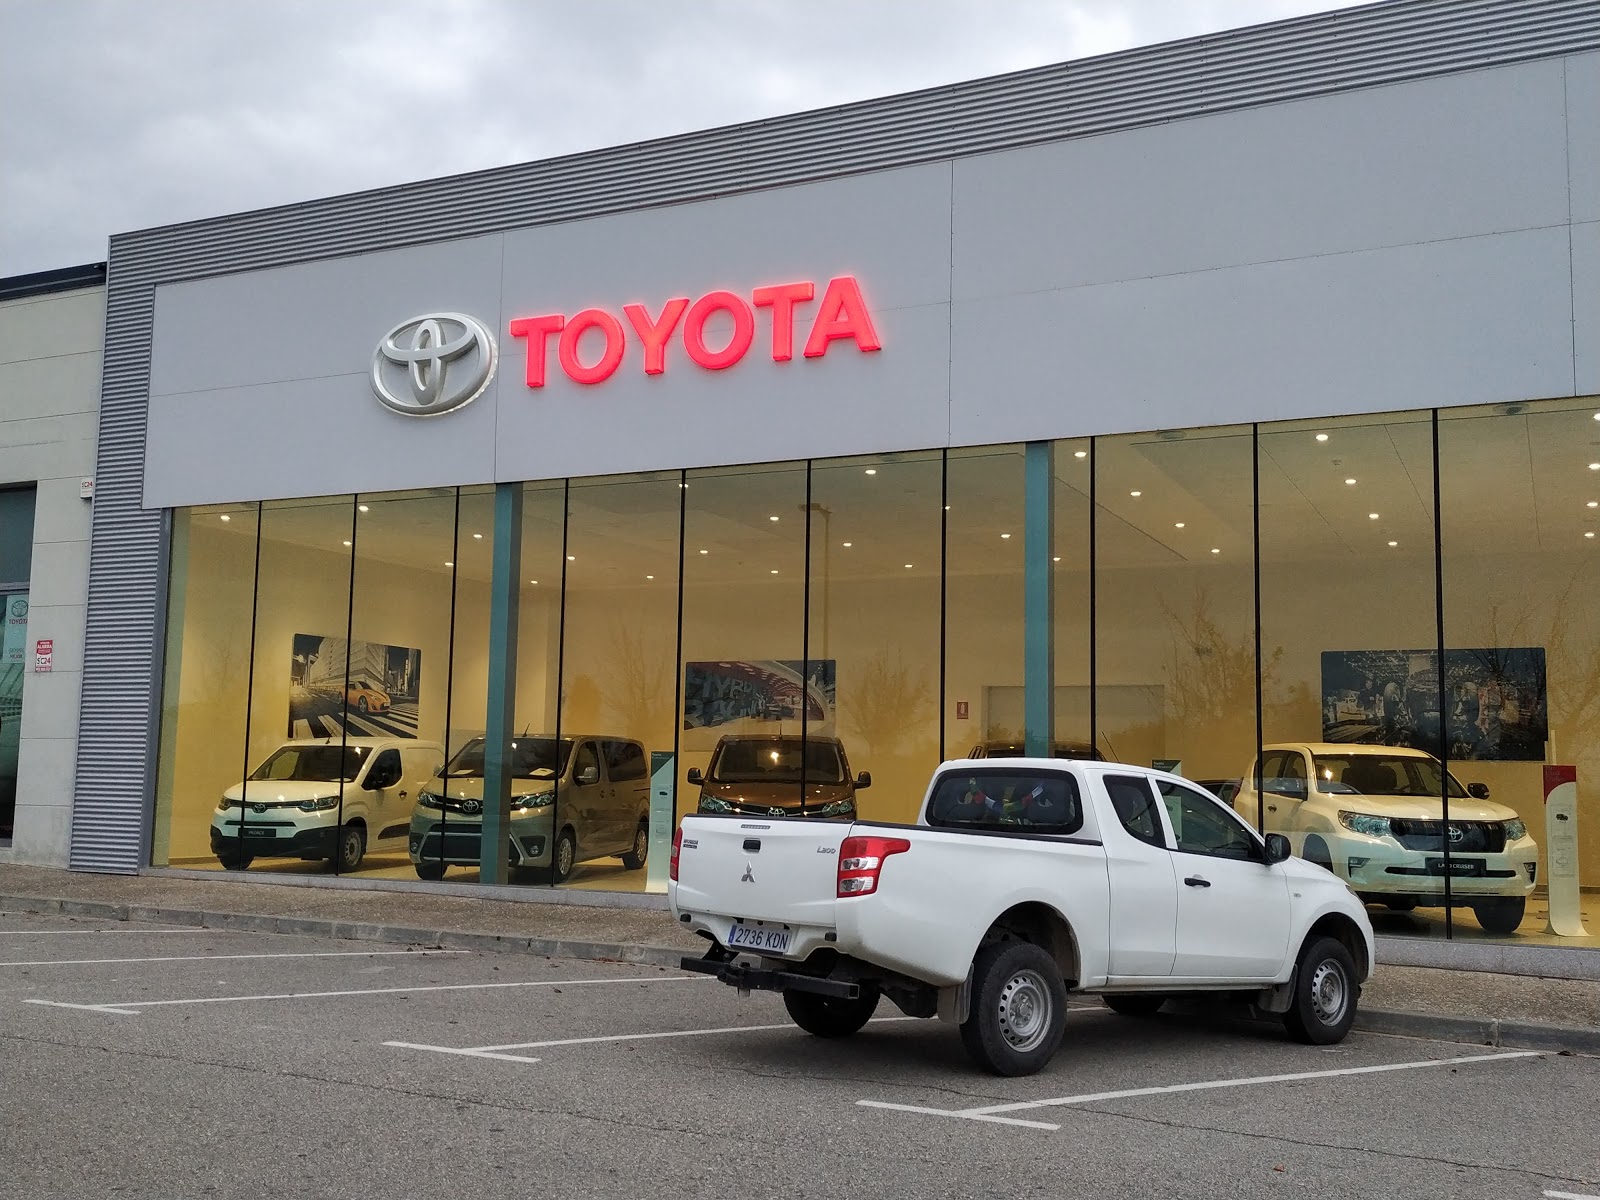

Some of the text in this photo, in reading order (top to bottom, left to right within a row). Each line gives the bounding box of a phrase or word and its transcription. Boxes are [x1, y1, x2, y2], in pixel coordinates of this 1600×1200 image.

[510, 275, 881, 388] TOYOTA
[734, 927, 789, 950] 2736 KDN
